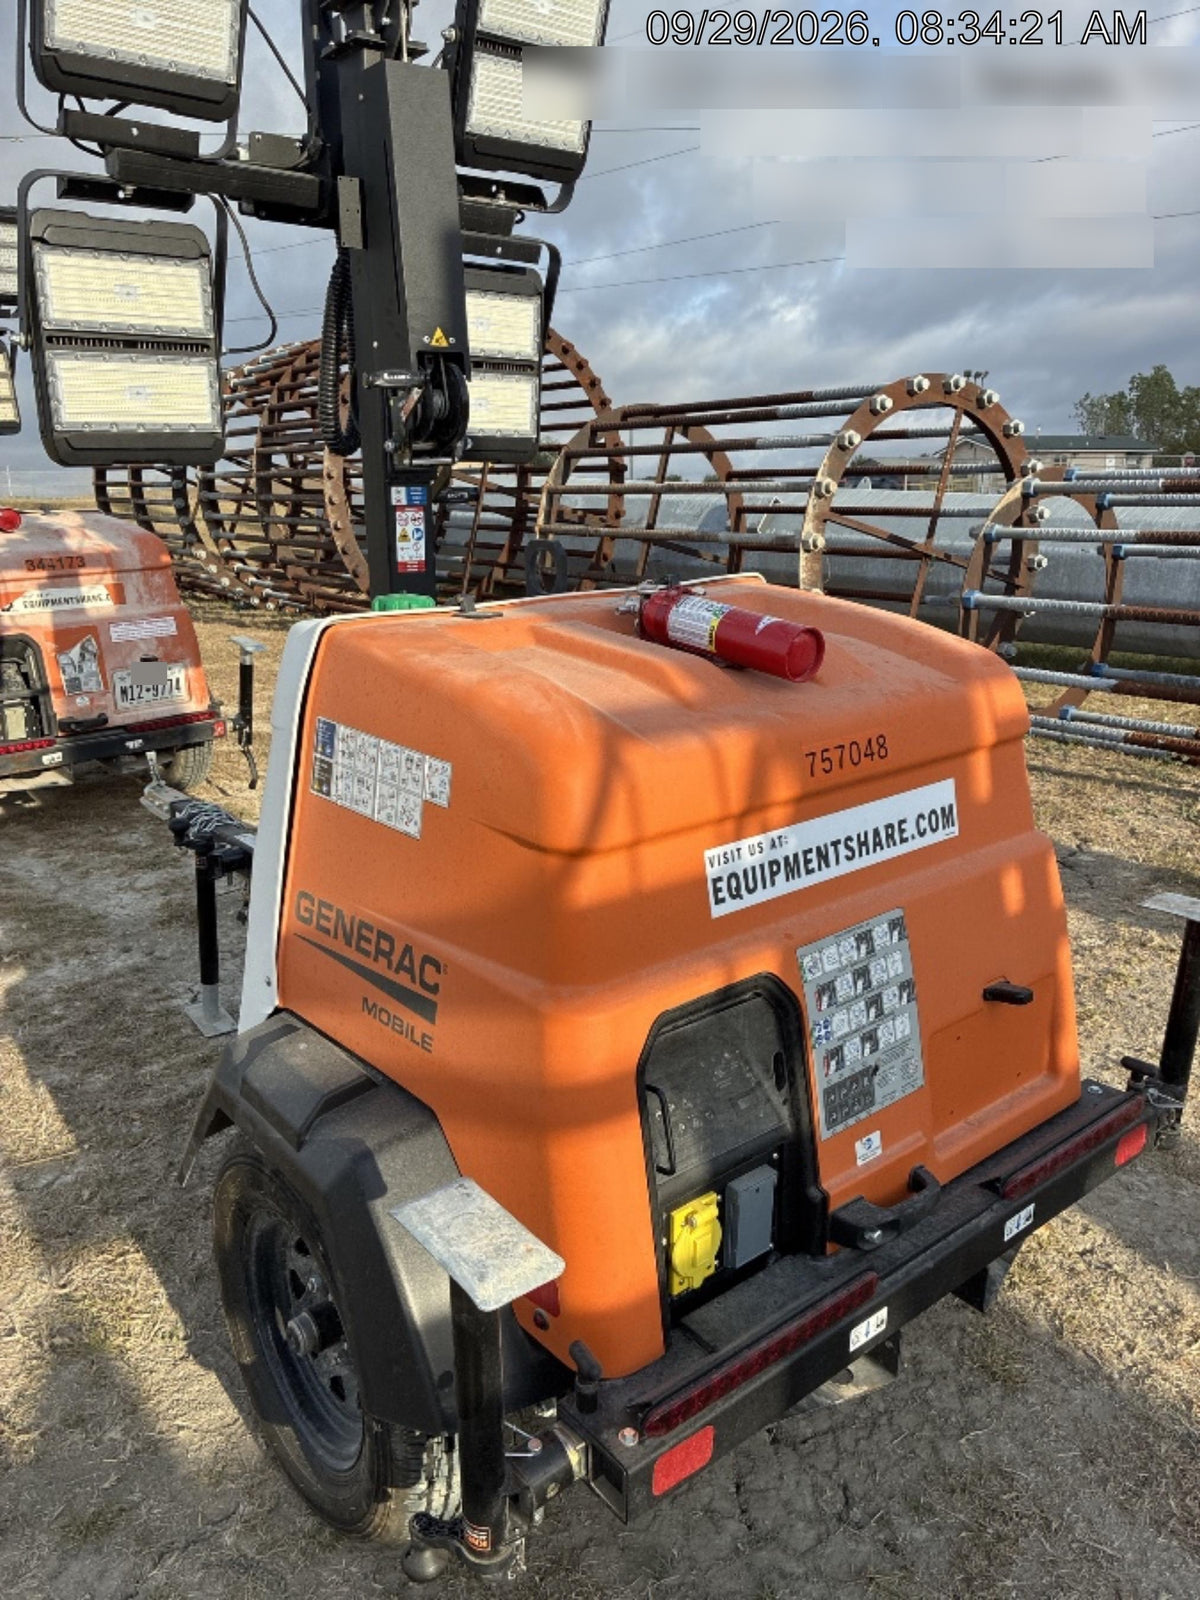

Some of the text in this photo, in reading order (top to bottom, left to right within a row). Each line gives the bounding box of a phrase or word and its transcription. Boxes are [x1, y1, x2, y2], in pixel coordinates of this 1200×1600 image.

[805, 734, 888, 777] 757048
[708, 835, 789, 868] VISIT US AT:
[711, 803, 955, 905] EQUIPMENTSHARE.COM
[294, 890, 442, 996] GENERAC
[361, 997, 433, 1053] MOBILE
